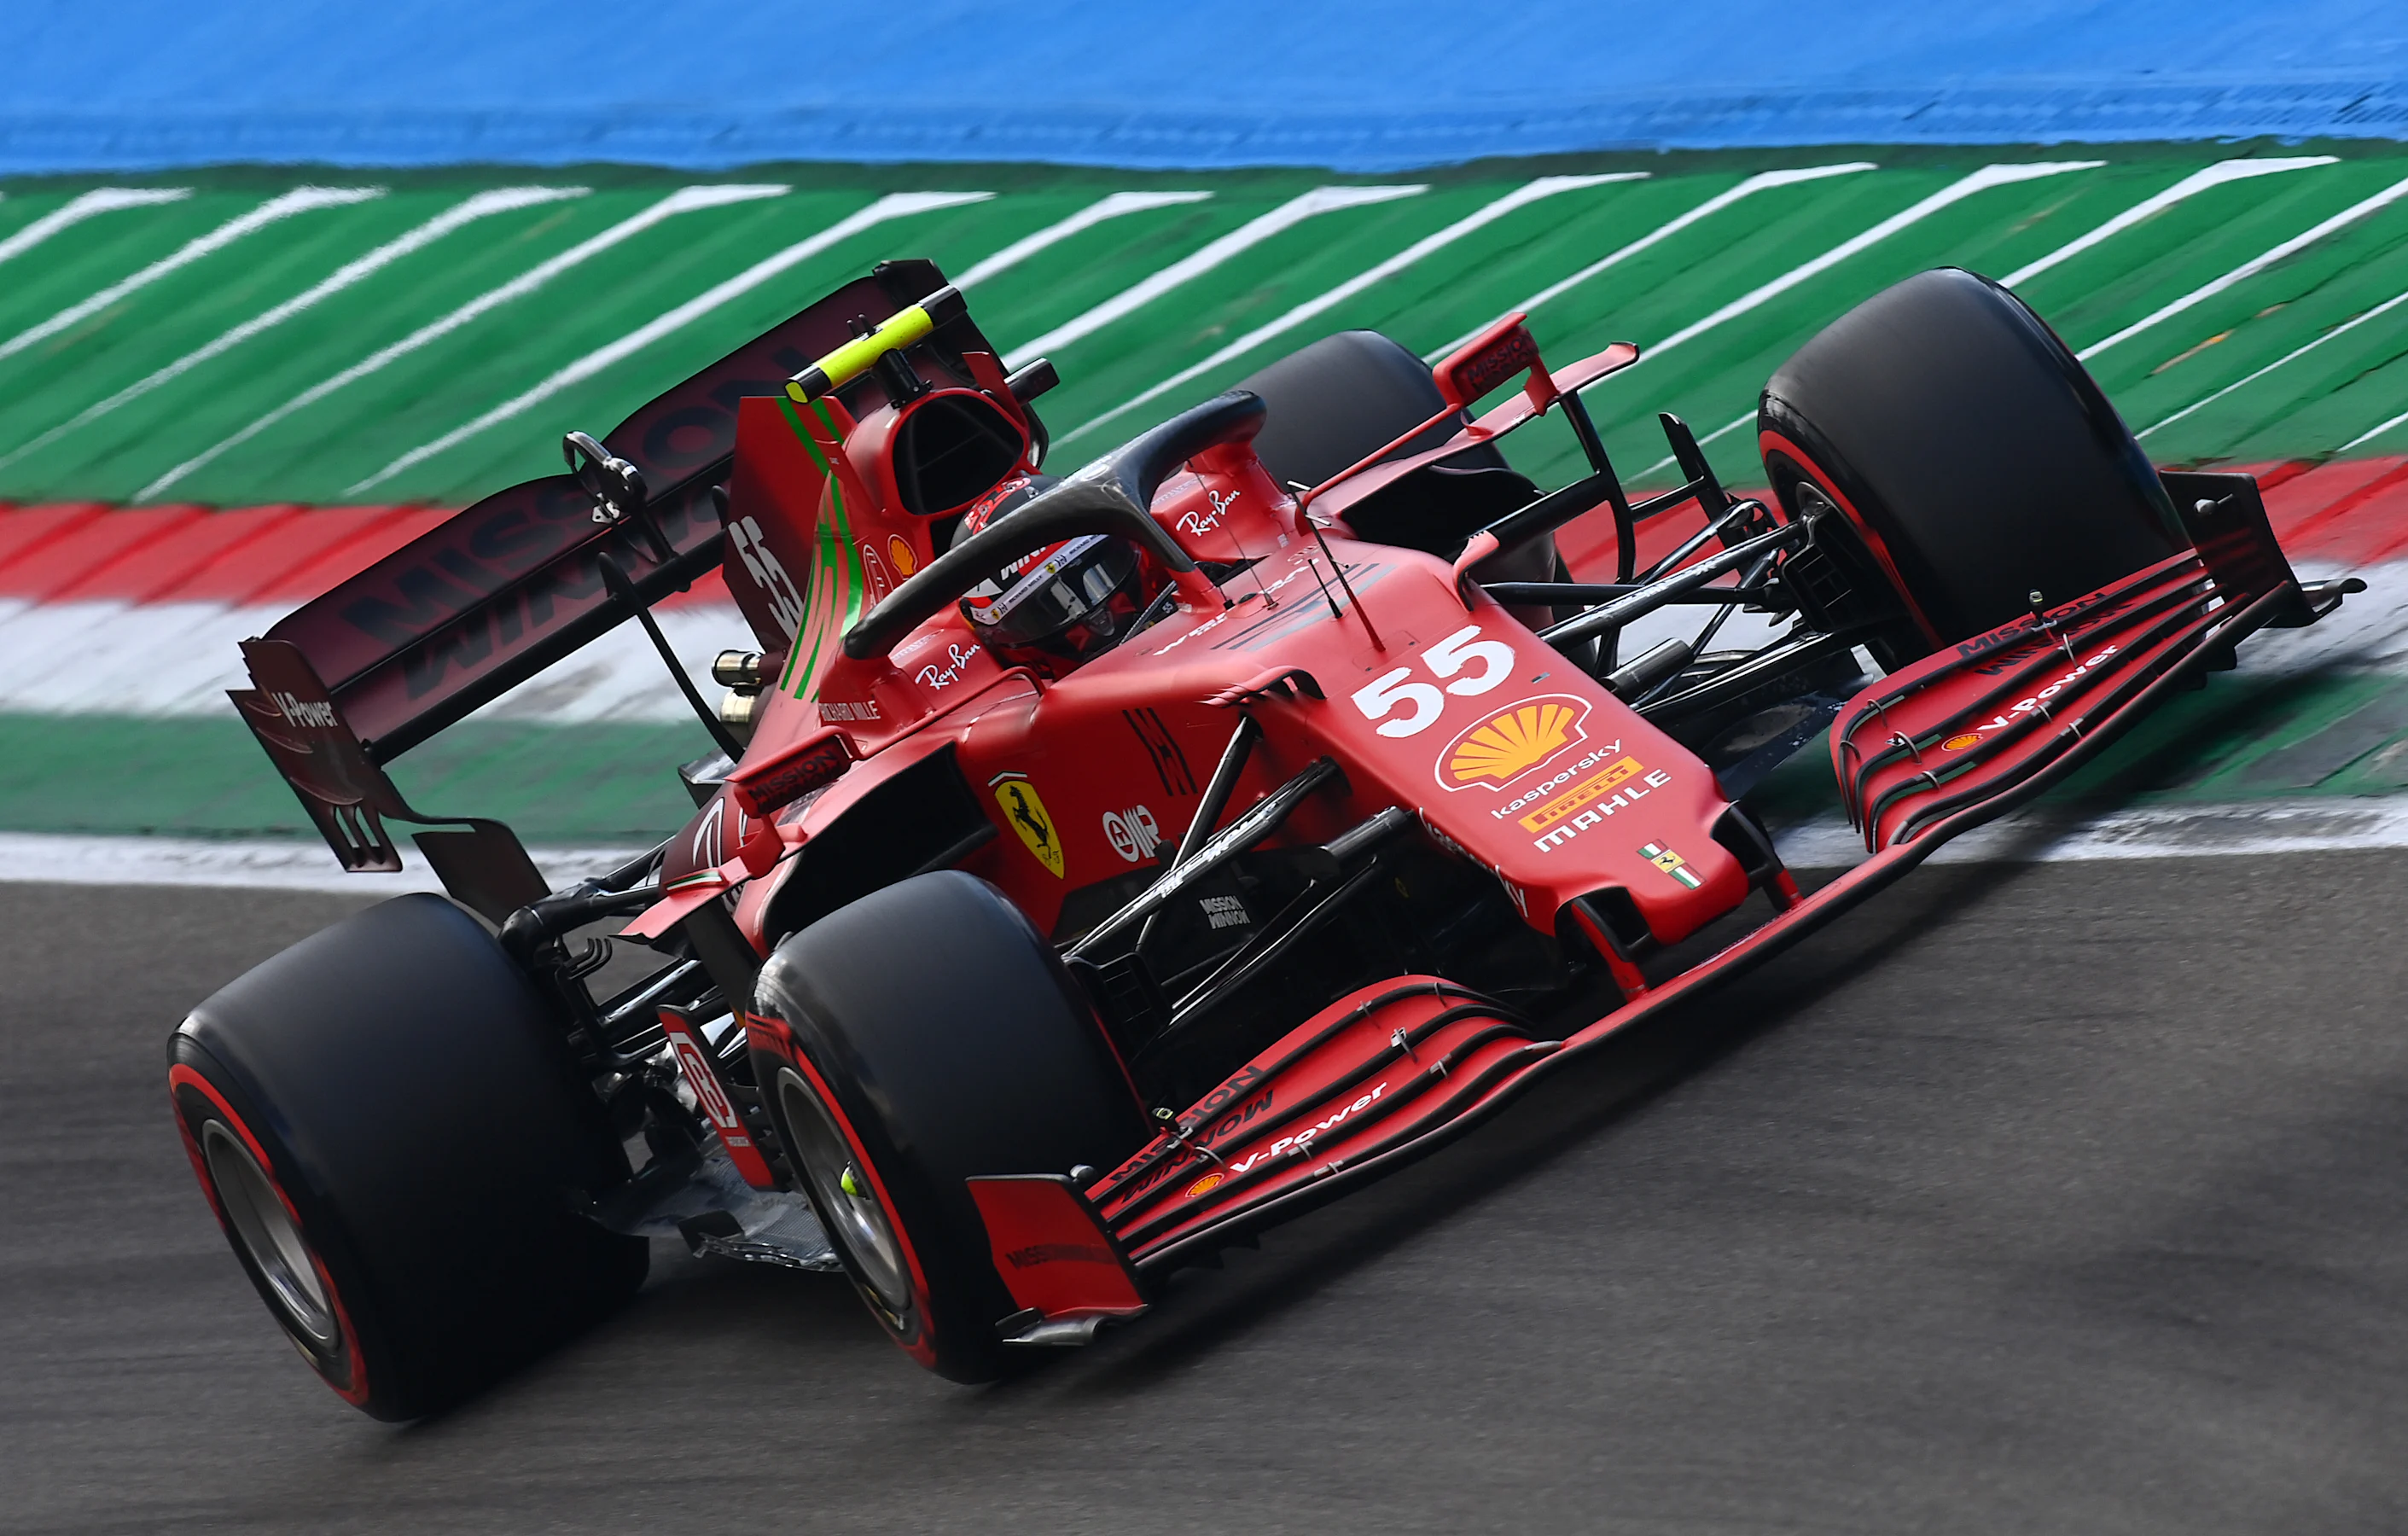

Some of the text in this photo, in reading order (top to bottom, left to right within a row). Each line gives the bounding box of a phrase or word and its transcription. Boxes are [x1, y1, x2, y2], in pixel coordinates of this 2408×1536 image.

[340, 346, 816, 649] MISSON
[272, 692, 339, 727] V-Power
[1351, 625, 1515, 738] 55
[1977, 644, 2118, 730] V-Power
[747, 750, 839, 800] MISSION
[1491, 738, 1621, 819] kaspersky
[1533, 769, 1672, 853] MAHLE
[1199, 896, 1244, 914] MISSION
[1230, 1081, 1387, 1172] V-Power
